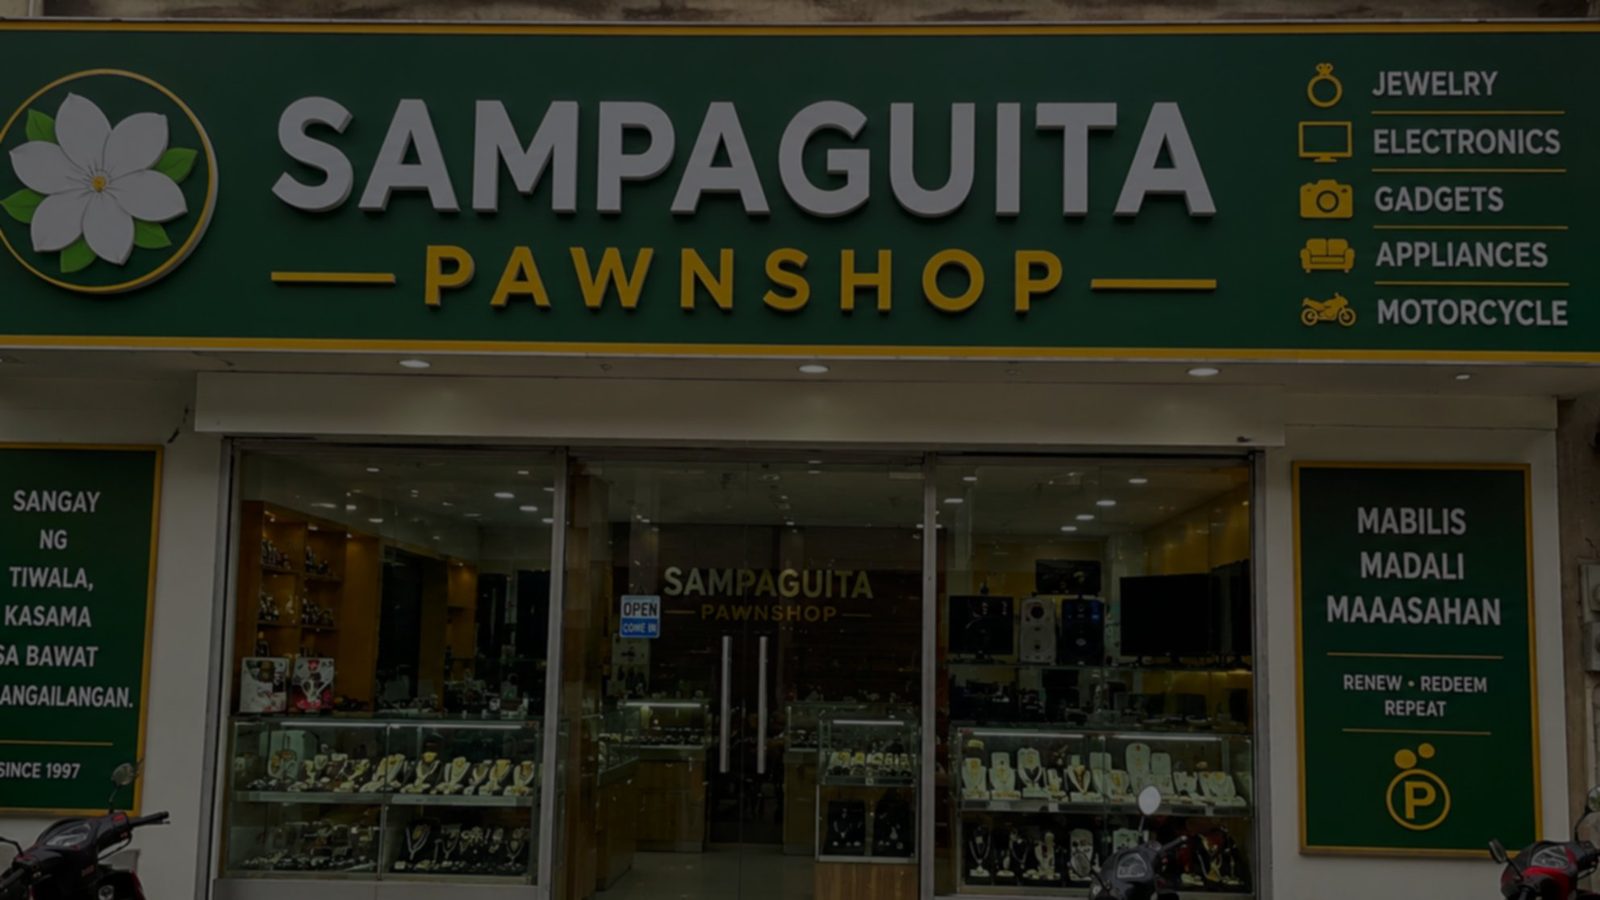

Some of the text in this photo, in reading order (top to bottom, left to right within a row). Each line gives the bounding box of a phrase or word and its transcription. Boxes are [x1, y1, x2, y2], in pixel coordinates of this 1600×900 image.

[1371, 70, 1499, 97] JEWELRY
[1373, 127, 1562, 156] ELECTRONICS
[272, 96, 1217, 217] SAMPAGUITA
[1374, 185, 1505, 212] GADGETS
[1376, 240, 1549, 268] APPLIANCES
[424, 244, 1064, 312] PAWNSHOP
[1377, 298, 1569, 327] MOTORCYCLE
[12, 489, 101, 513] SANGAY
[1357, 506, 1467, 536] MABILIS
[39, 528, 68, 550] NG
[8, 566, 94, 592] TIWALA,
[1360, 551, 1465, 581] MADALI
[663, 566, 874, 600] SAMPAGUITA
[4, 604, 92, 628] KASAMA
[623, 601, 658, 617] OPEN
[700, 603, 838, 623] PAWNSHOP
[1327, 595, 1501, 626] MAAASAHAN
[25, 644, 99, 668] BAWAT
[1343, 673, 1488, 693] RENEW REDEEM
[1384, 699, 1447, 718] REPEAT
[45, 762, 81, 780] 1997
